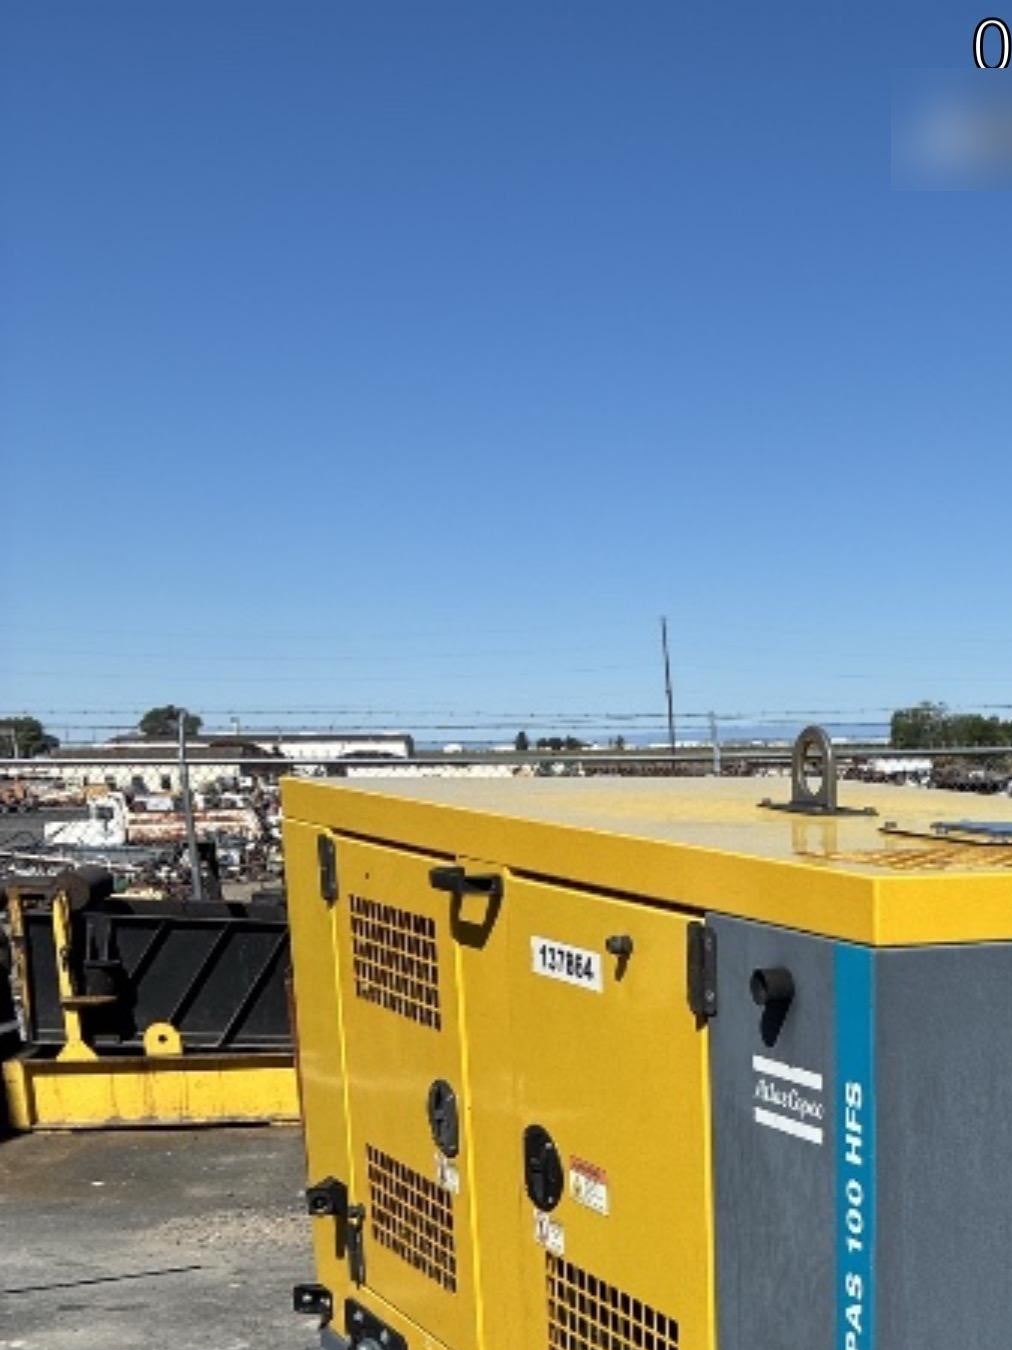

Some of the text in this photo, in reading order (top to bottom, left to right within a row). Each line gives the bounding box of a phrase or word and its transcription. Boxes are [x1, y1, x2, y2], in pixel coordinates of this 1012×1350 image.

[539, 944, 594, 981] 137864
[788, 1088, 825, 1120] Copco
[845, 1081, 863, 1166] HFS
[845, 1178, 864, 1253] 100
